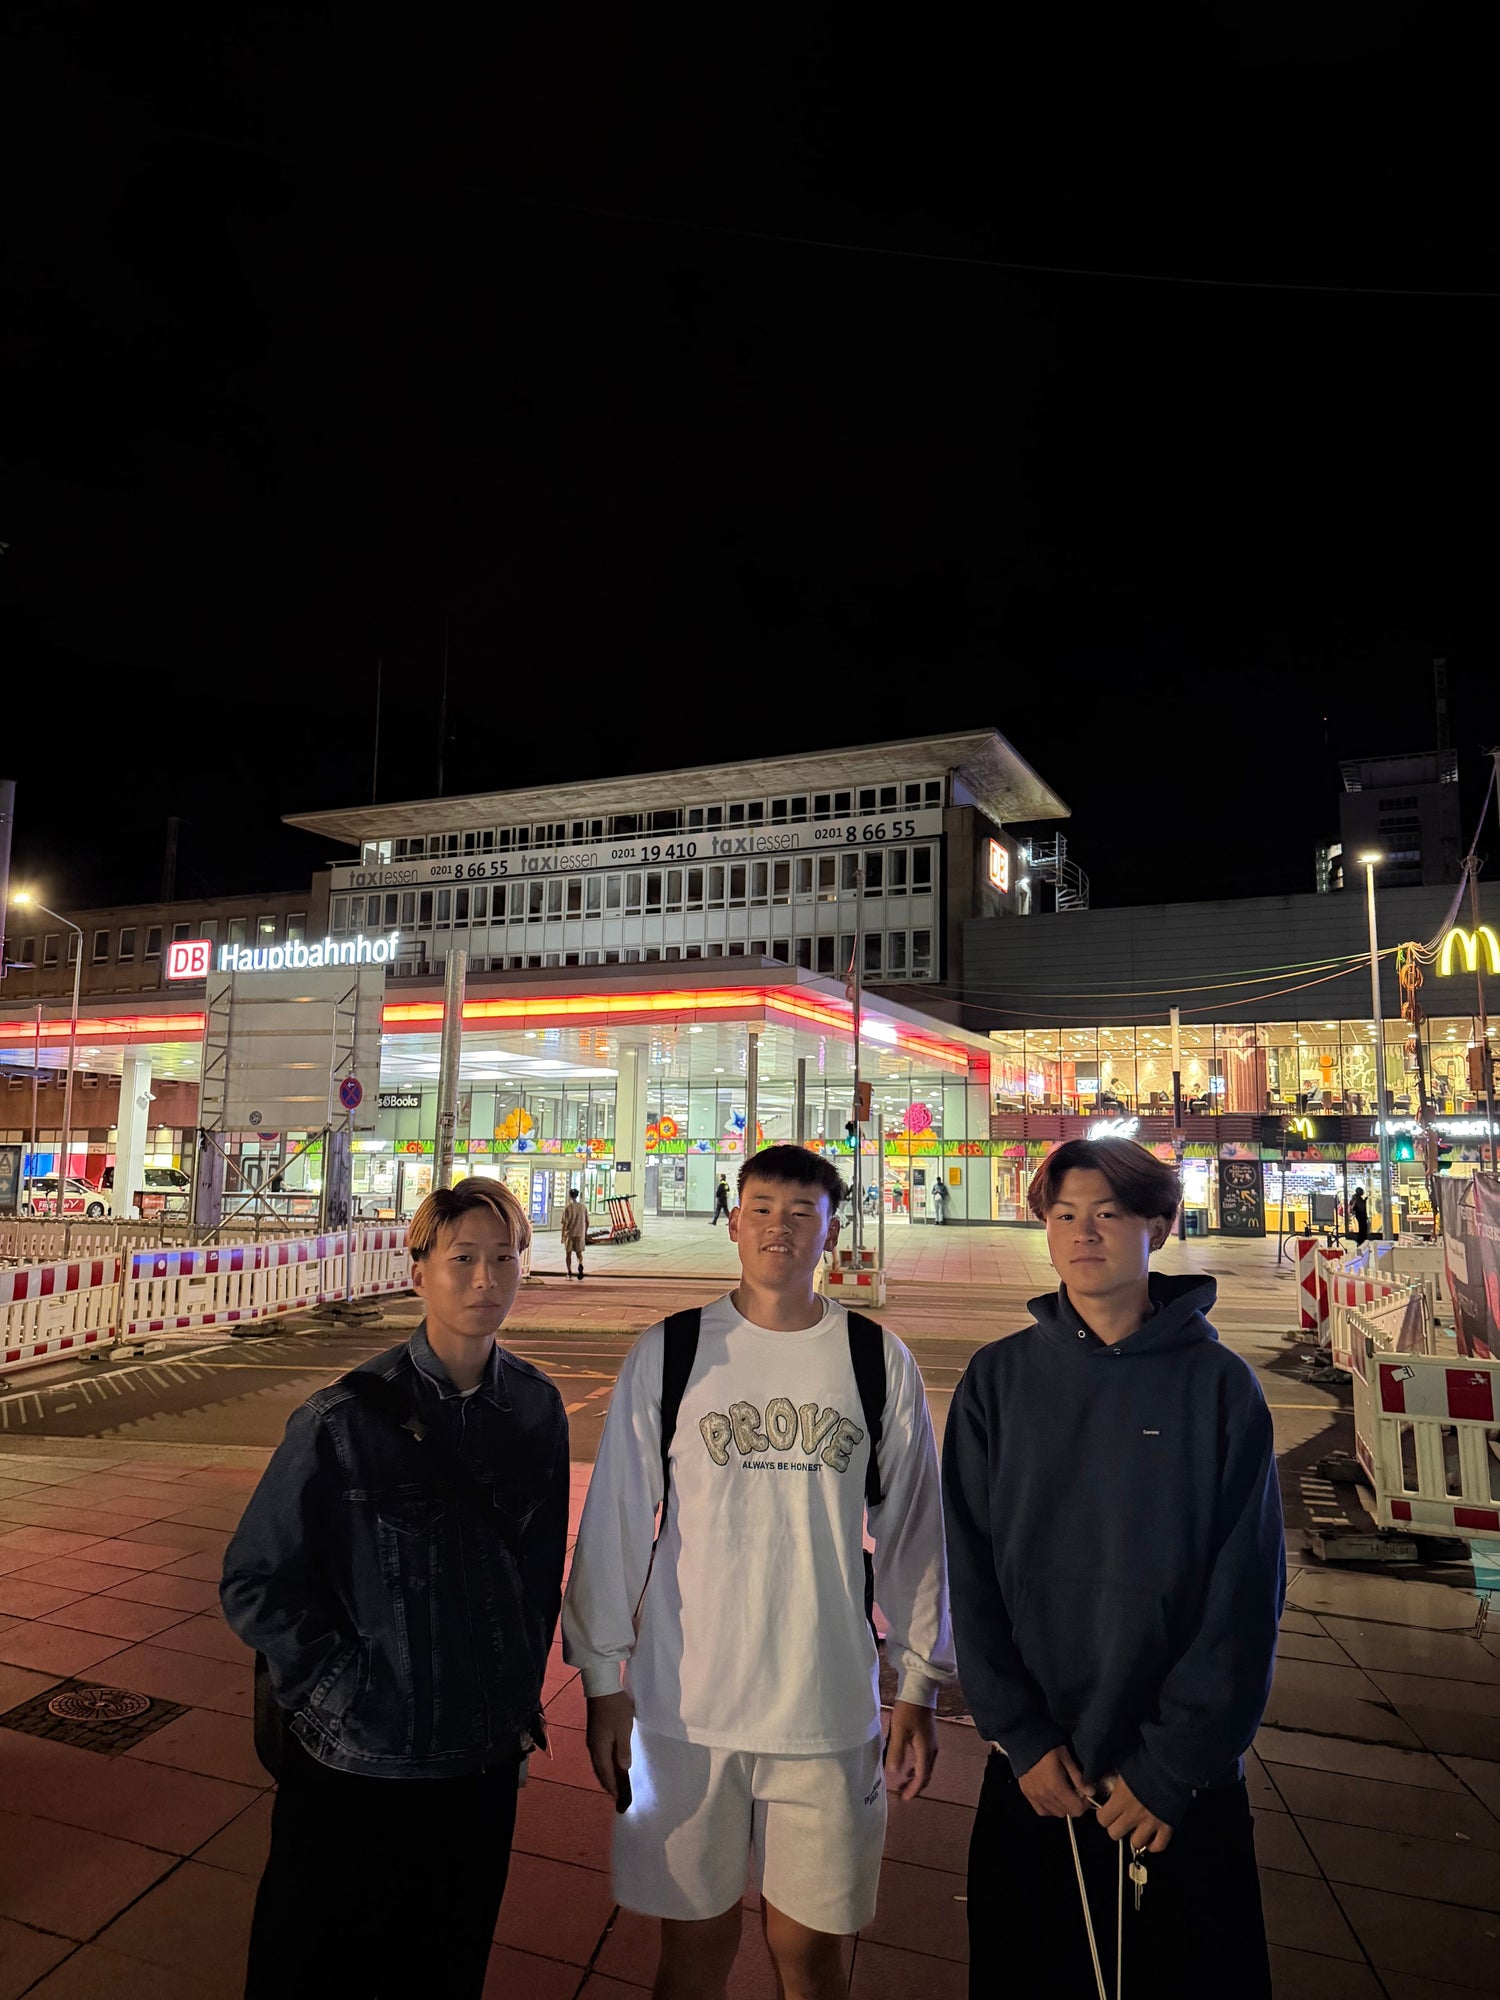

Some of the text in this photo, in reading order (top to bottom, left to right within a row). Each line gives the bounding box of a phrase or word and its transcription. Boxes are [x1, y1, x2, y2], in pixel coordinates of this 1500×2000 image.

[430, 865, 452, 876] 0201
[455, 864, 463, 878] 8
[468, 862, 486, 877] 66
[490, 860, 508, 876] 55
[611, 848, 636, 859] 0201
[641, 845, 660, 862] 19
[665, 842, 697, 859] 410
[814, 828, 843, 840] 0201
[846, 825, 857, 842] 8
[862, 823, 886, 841] 66
[892, 820, 915, 838] 55
[174, 931, 399, 973] DB Hauptbahnhof
[699, 1397, 864, 1473] PROVE
[742, 1460, 823, 1472] ALWAYS BE HONEST
